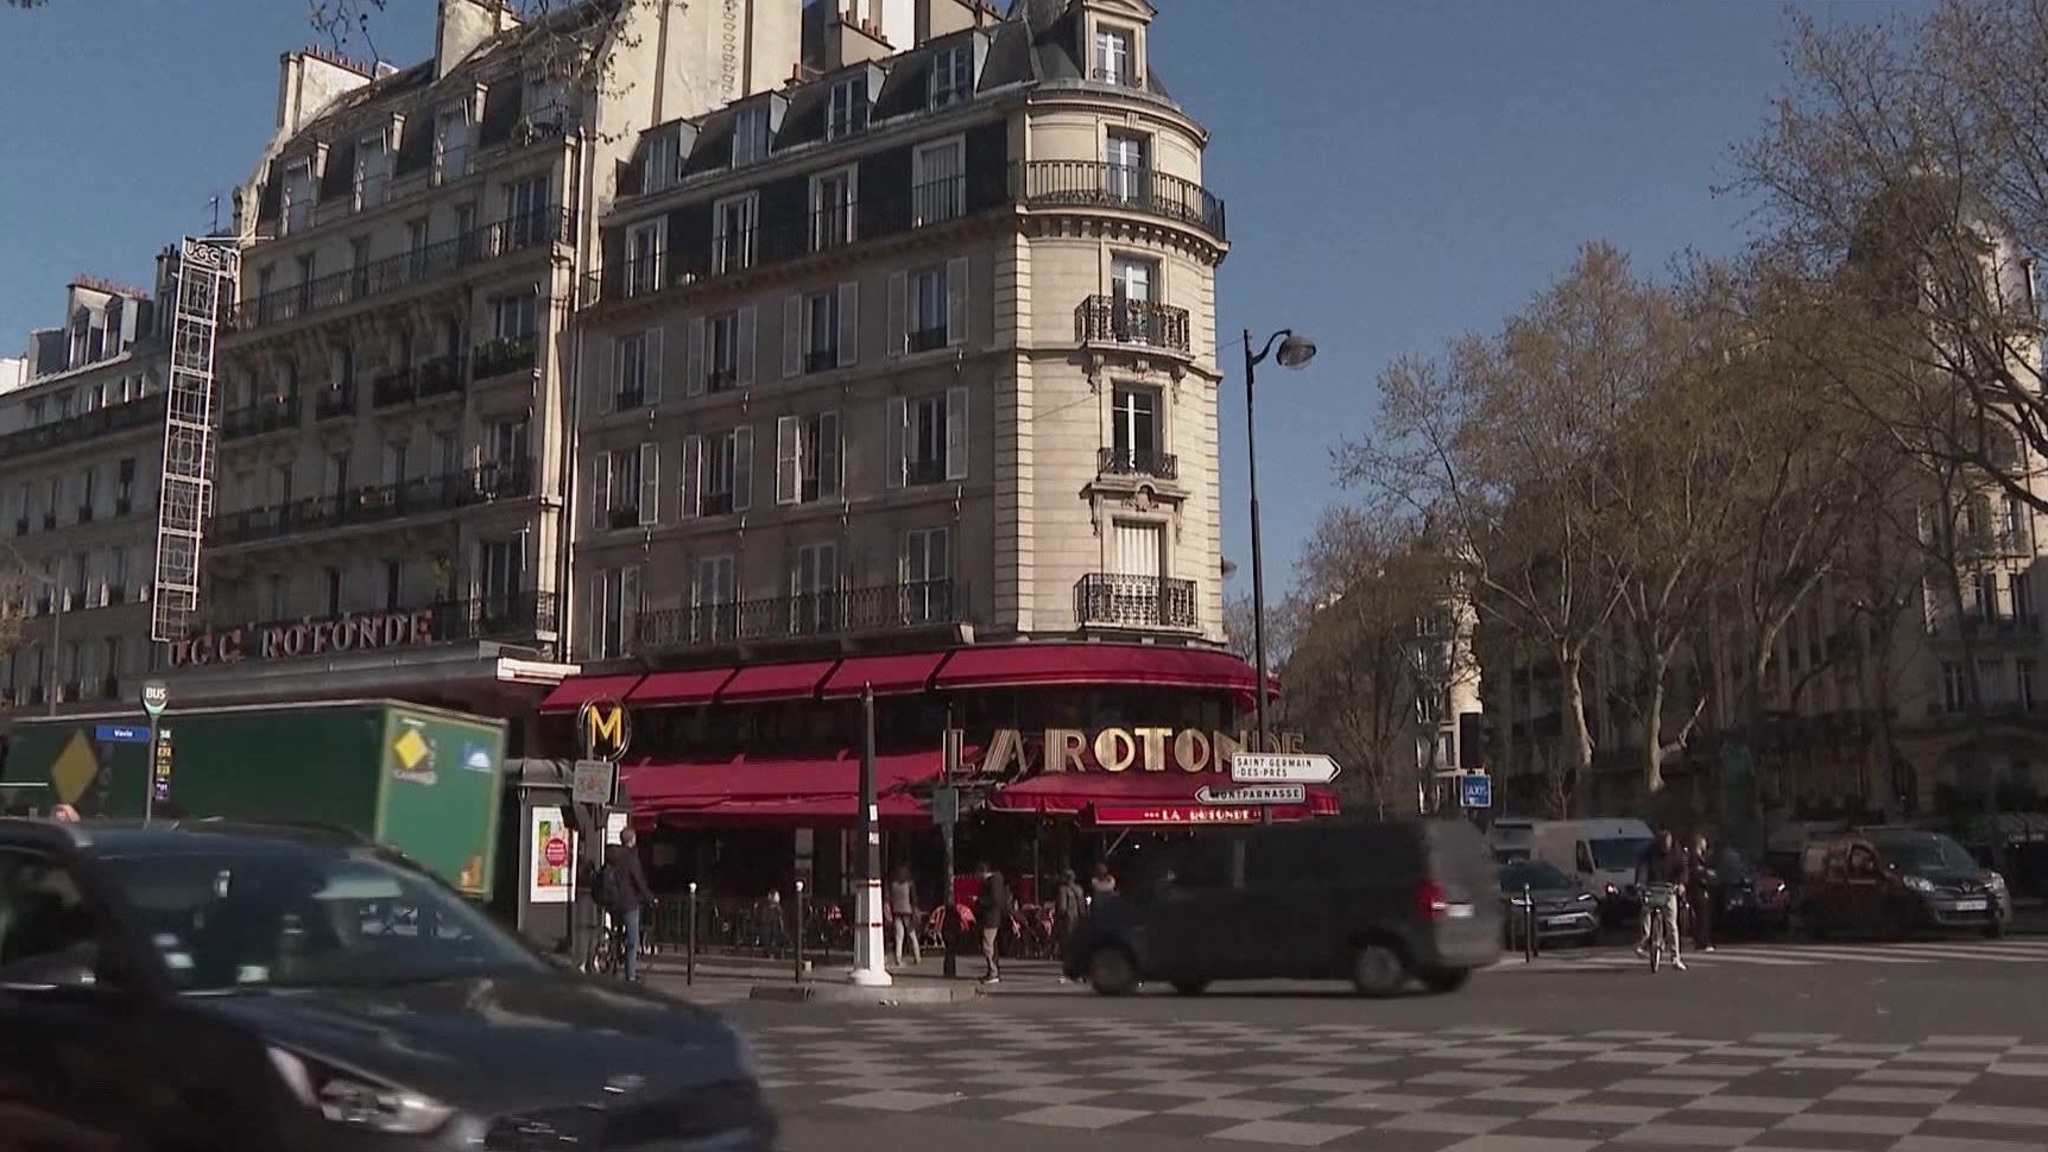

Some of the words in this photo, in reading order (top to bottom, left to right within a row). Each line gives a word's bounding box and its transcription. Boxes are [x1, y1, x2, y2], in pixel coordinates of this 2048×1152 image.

[186, 240, 219, 263] UGC
[261, 610, 434, 659] ROTONDE
[146, 687, 167, 700] BUS
[590, 705, 623, 748] M
[113, 729, 133, 738] Vavin
[942, 728, 1032, 772] LA
[1237, 758, 1264, 767] SAINT
[1269, 758, 1312, 768] GERMAIN
[1210, 788, 1299, 799] MONTPARNASSE
[1162, 809, 1180, 821] LA
